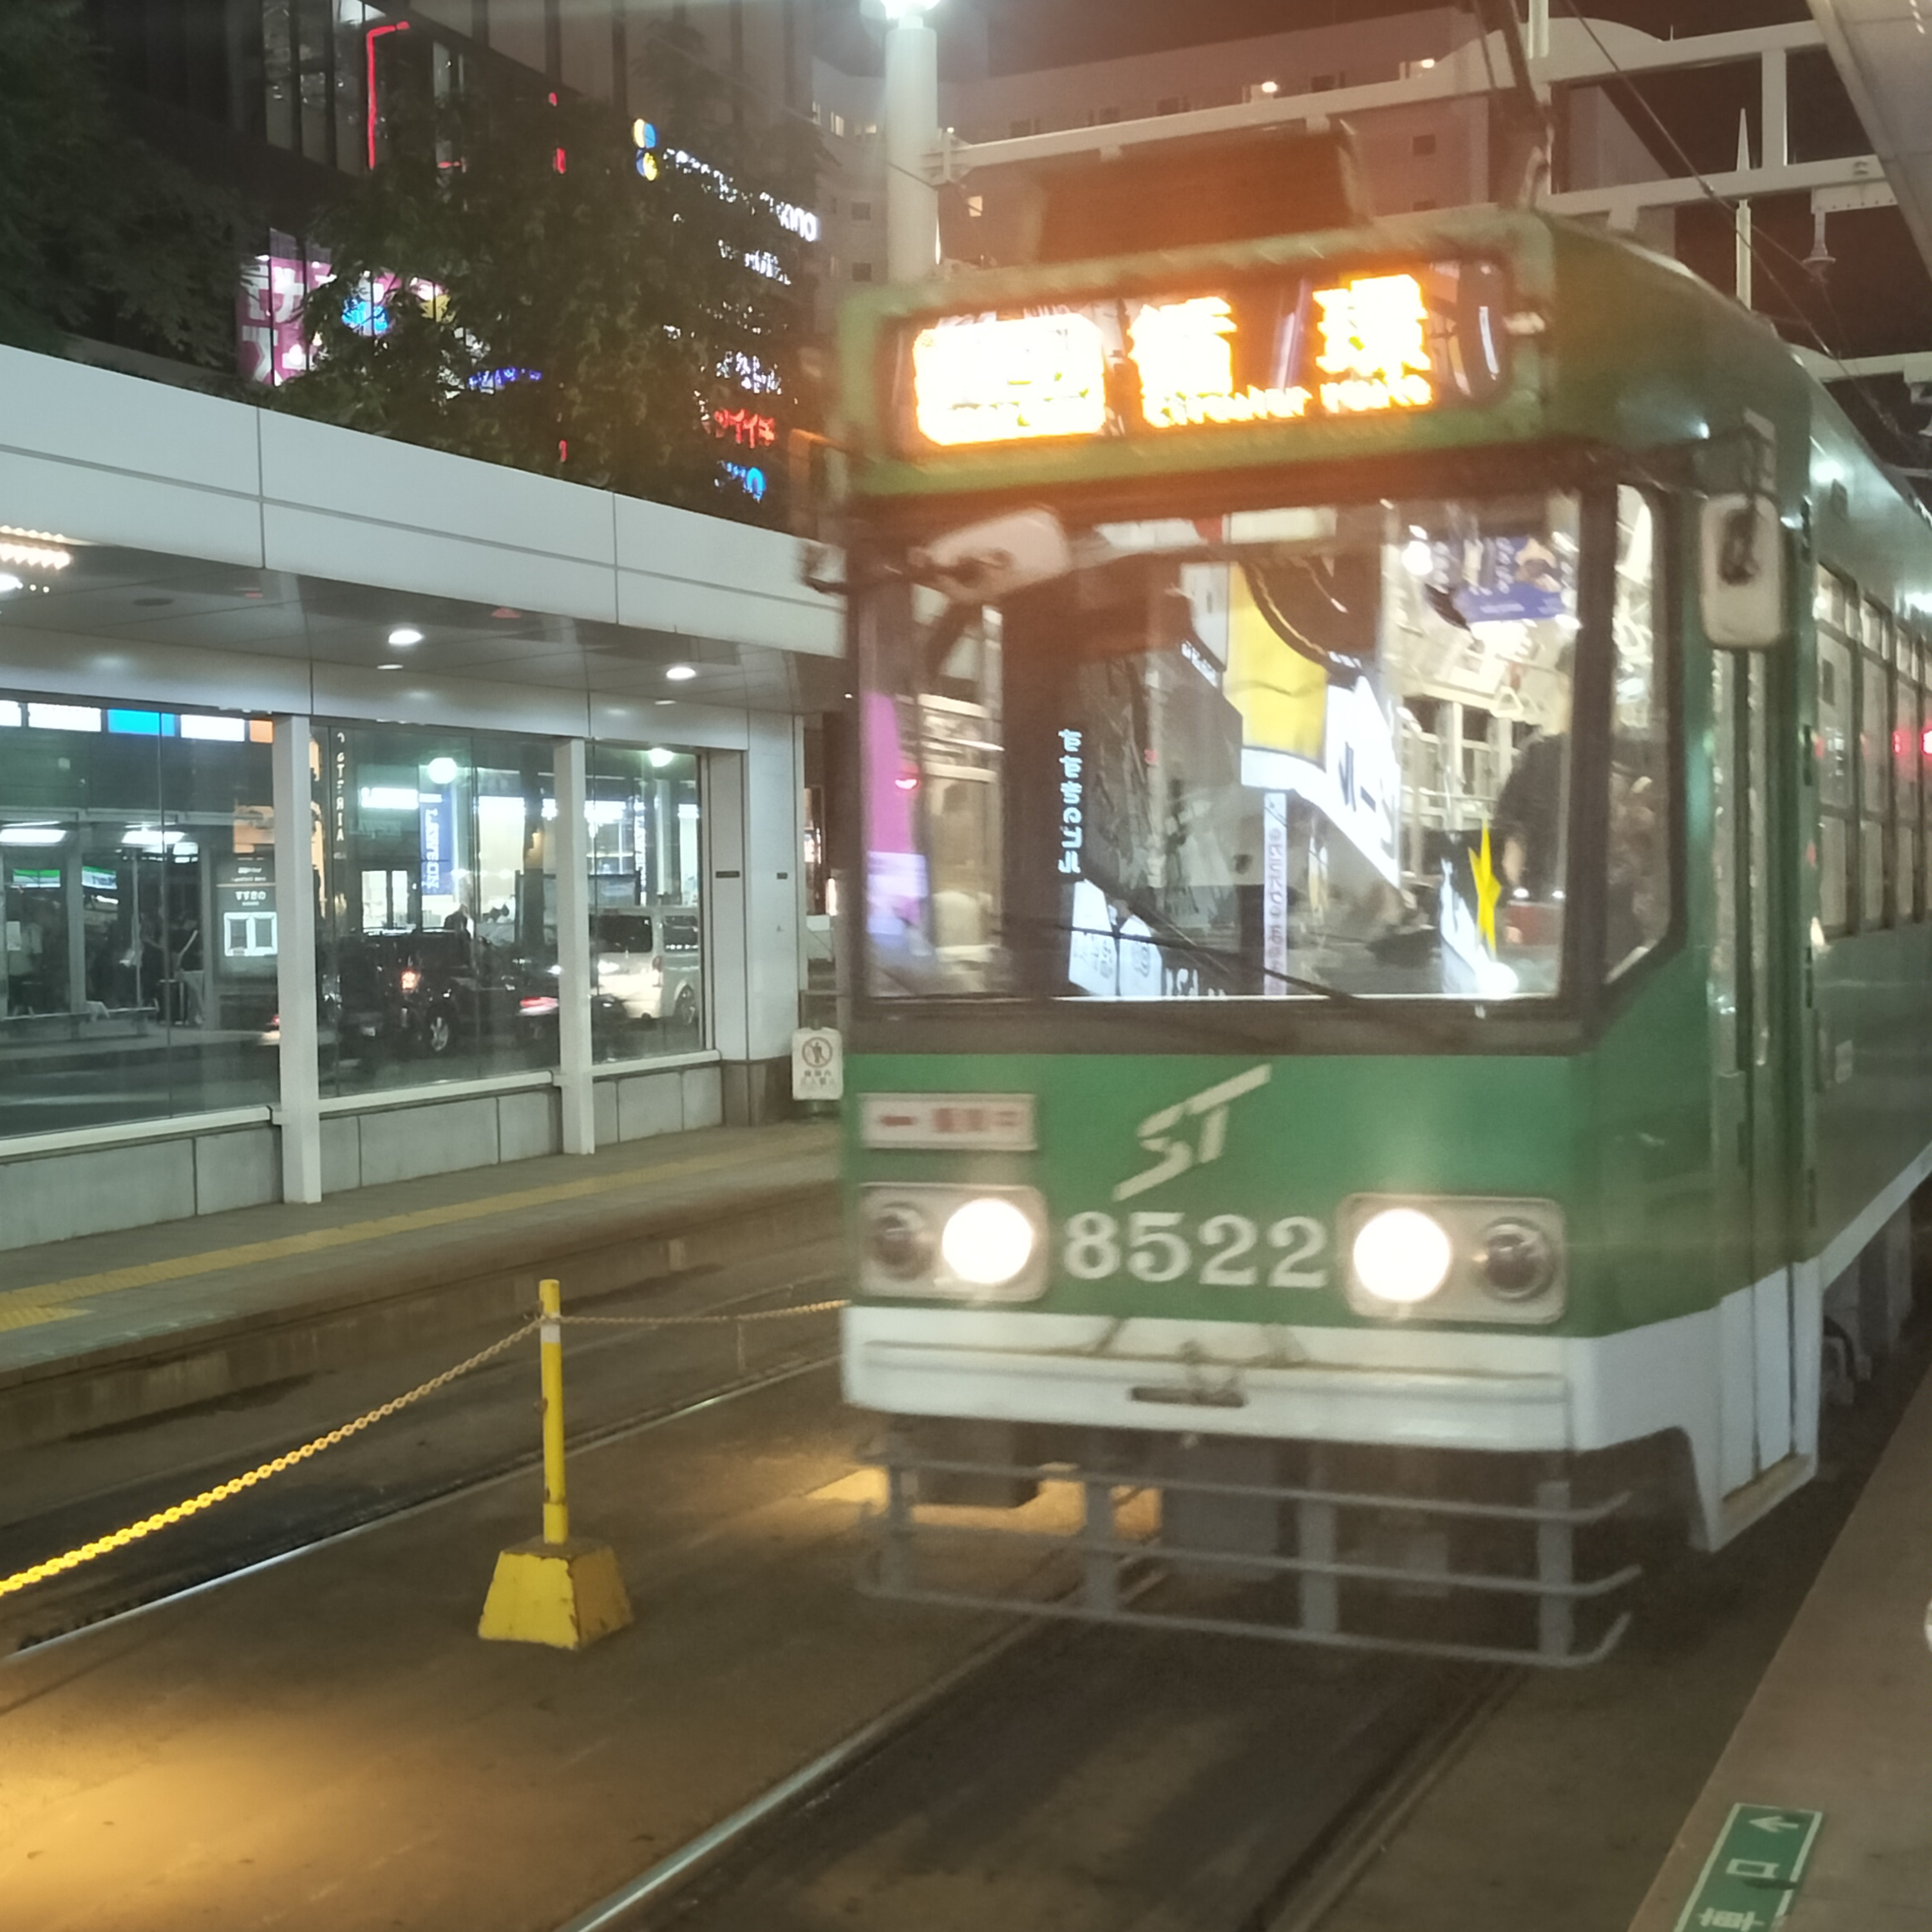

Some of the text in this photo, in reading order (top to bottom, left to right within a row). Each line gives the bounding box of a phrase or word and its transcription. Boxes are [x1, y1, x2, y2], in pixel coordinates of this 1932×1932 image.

[423, 808, 440, 890] LAWSON
[1111, 1063, 1273, 1202] ST
[1063, 1211, 1329, 1289] 8522
